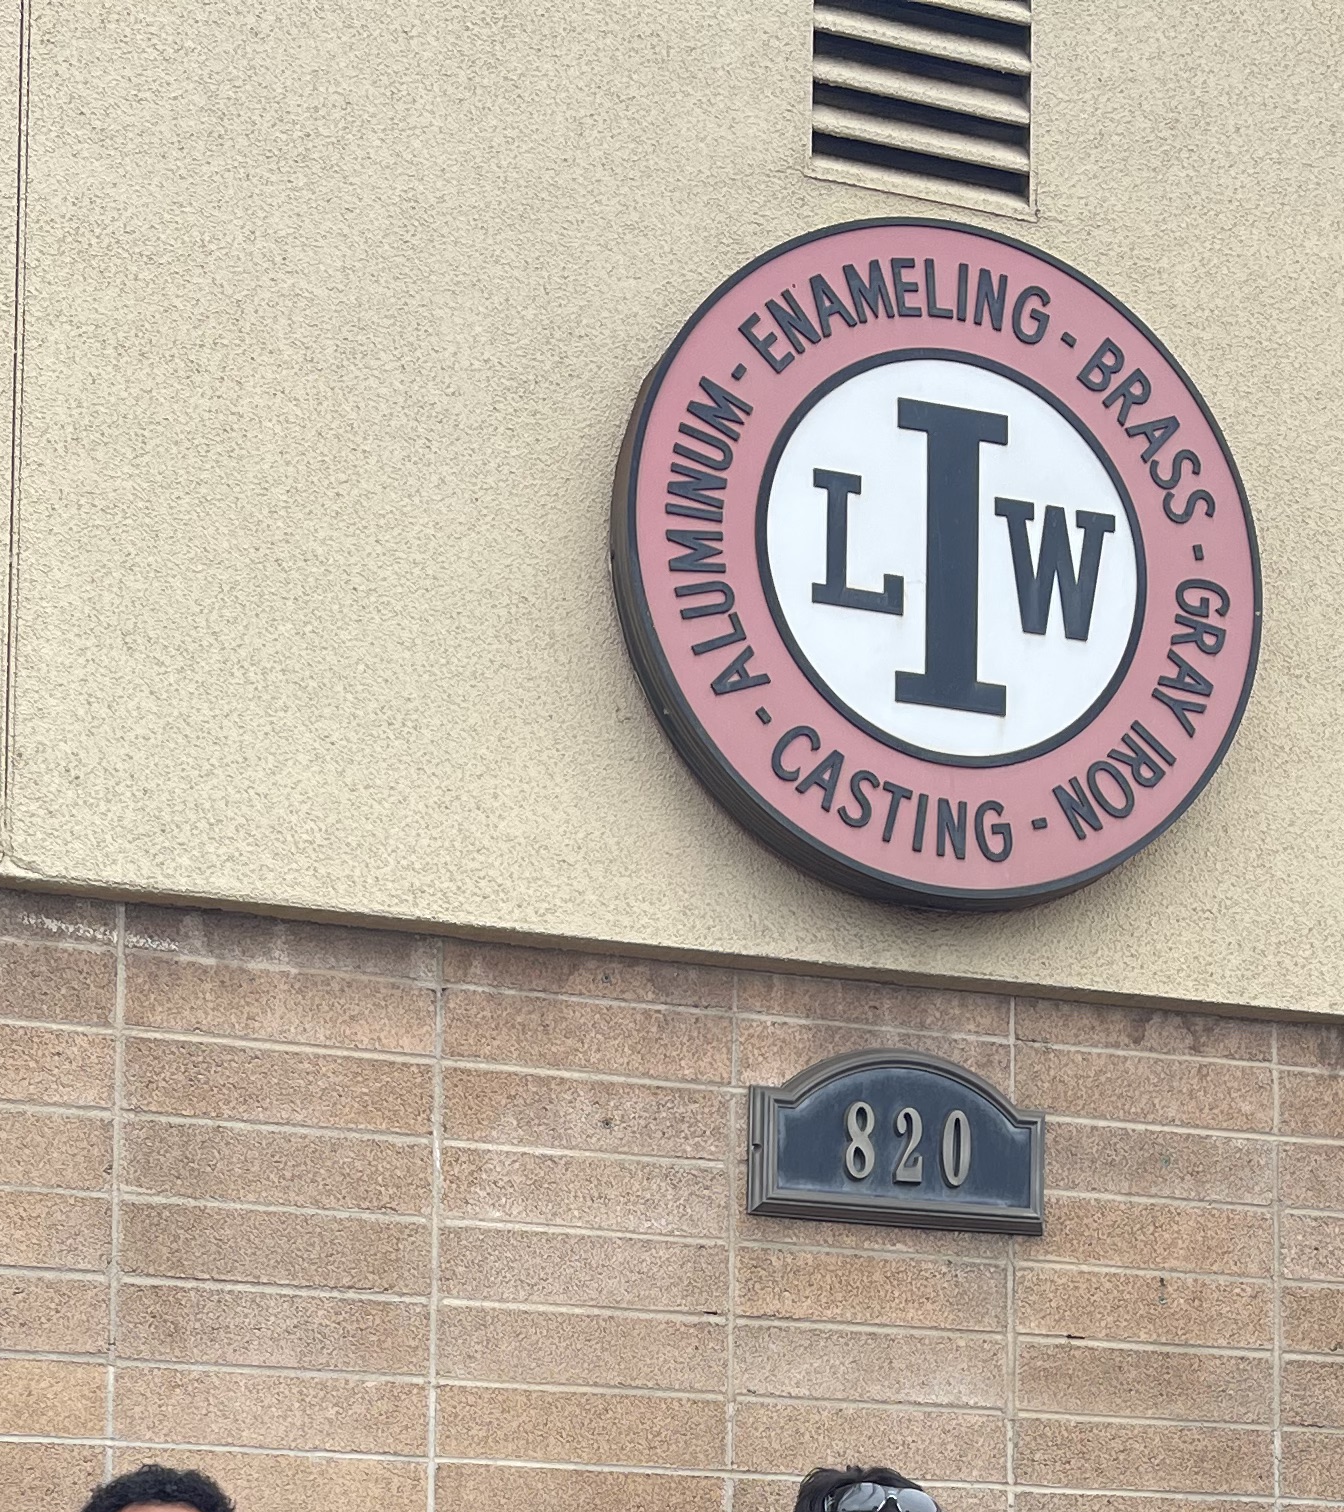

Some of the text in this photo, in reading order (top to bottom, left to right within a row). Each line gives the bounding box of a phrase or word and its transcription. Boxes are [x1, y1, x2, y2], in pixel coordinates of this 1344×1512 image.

[665, 257, 1230, 862] ALUMINUM ENAMELING BRASS GRAY IRON CASTING
[844, 1101, 972, 1188] 820
